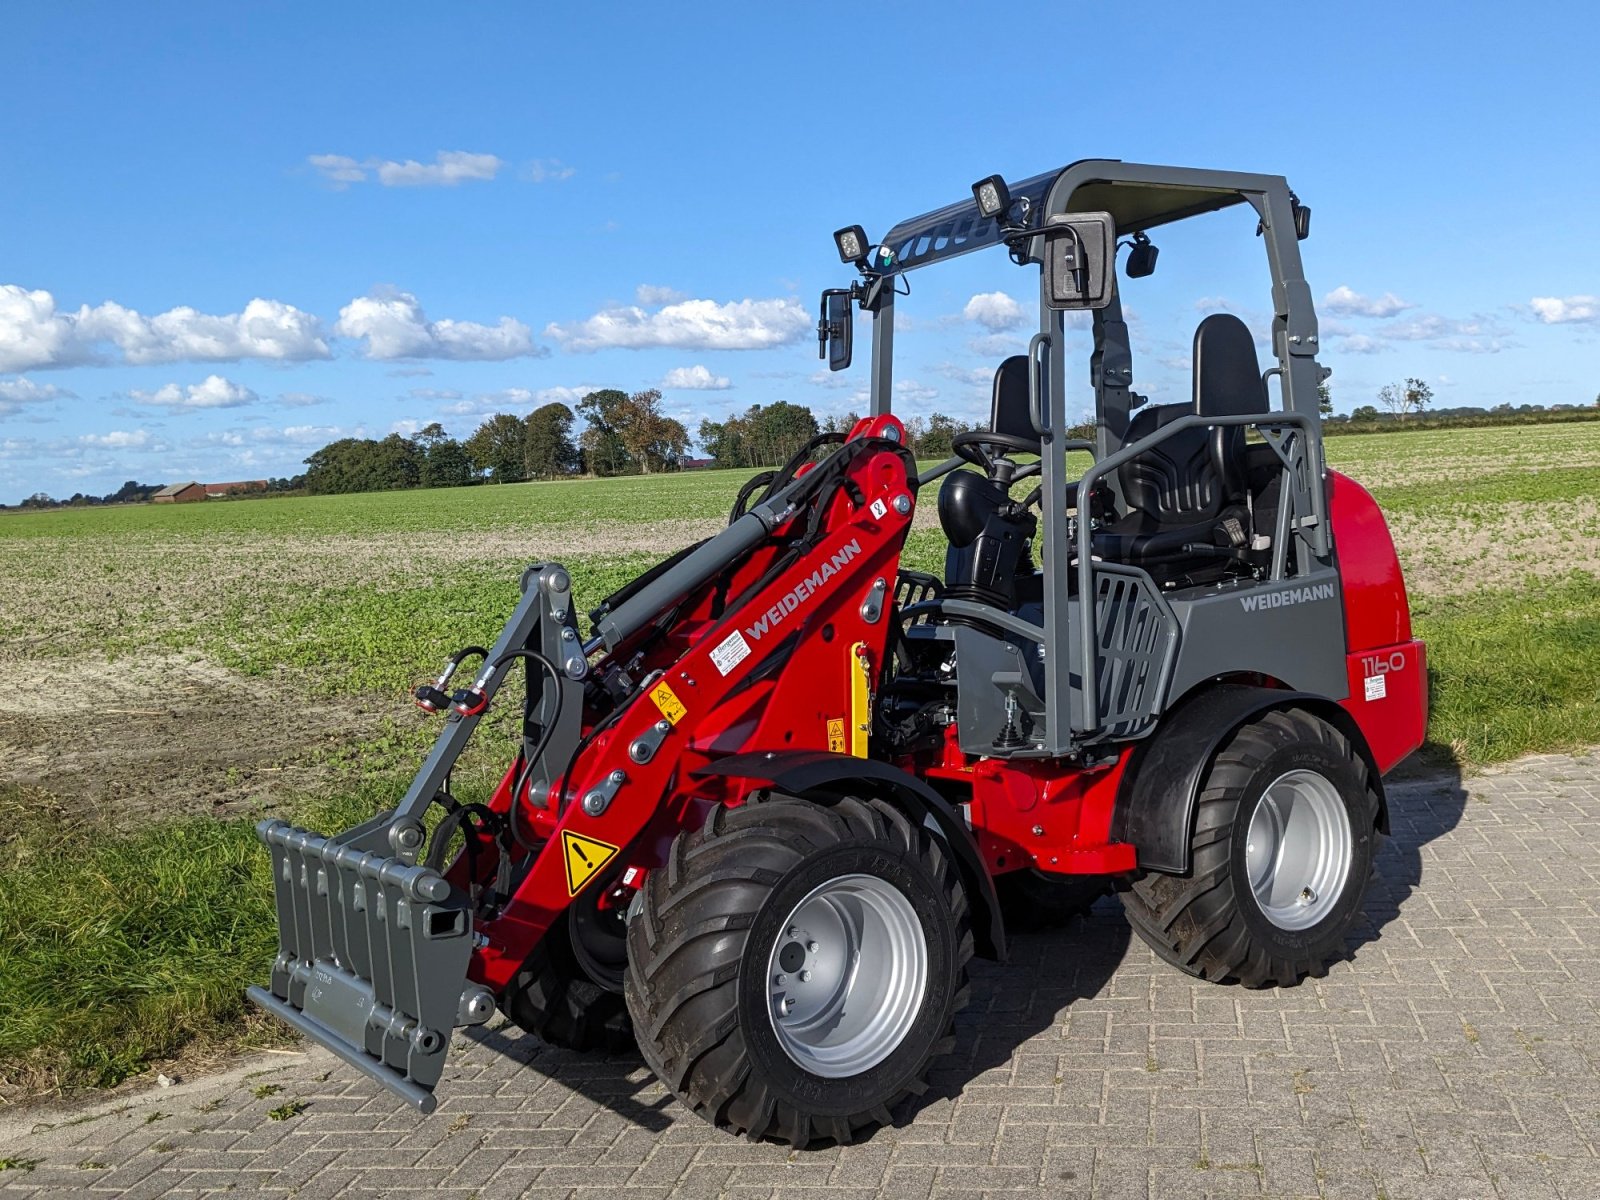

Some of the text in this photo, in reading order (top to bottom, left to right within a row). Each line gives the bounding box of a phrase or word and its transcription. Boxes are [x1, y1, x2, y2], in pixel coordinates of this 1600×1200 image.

[745, 538, 862, 641] WEIDEMANN
[1240, 583, 1335, 613] WEIDEMANN
[1361, 651, 1405, 677] 1160
